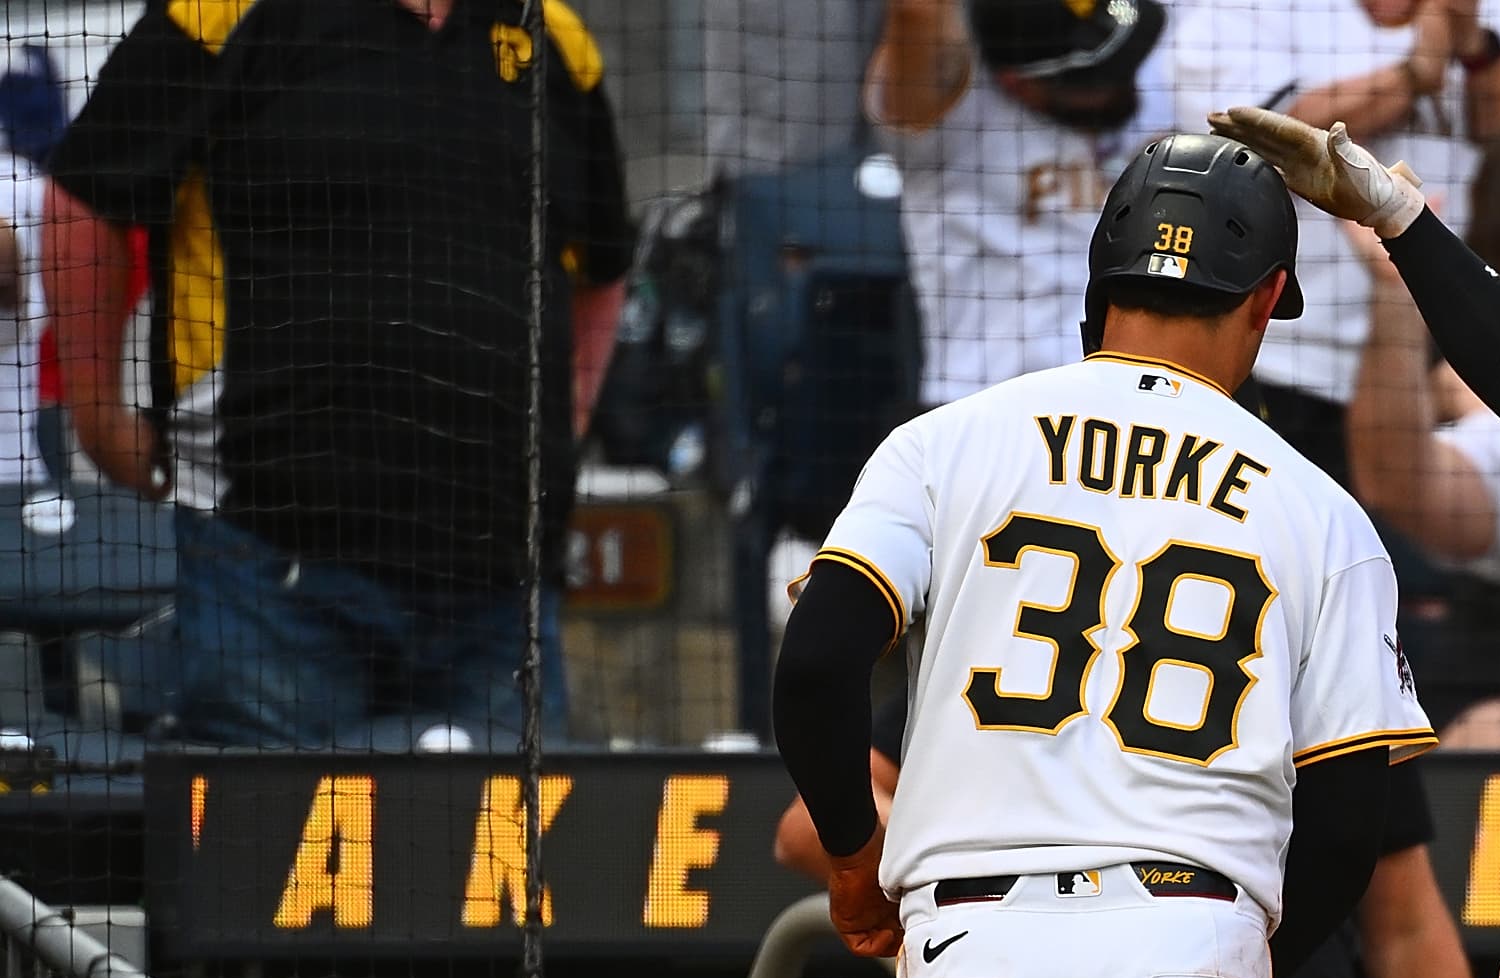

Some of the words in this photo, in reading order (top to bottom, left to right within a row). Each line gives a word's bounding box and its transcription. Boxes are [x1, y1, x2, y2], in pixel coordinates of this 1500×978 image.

[1154, 223, 1193, 254] 38
[1033, 414, 1271, 524] YORKE
[961, 511, 1279, 768] 38
[191, 775, 730, 928] AKE
[1140, 867, 1195, 884] YORKE
